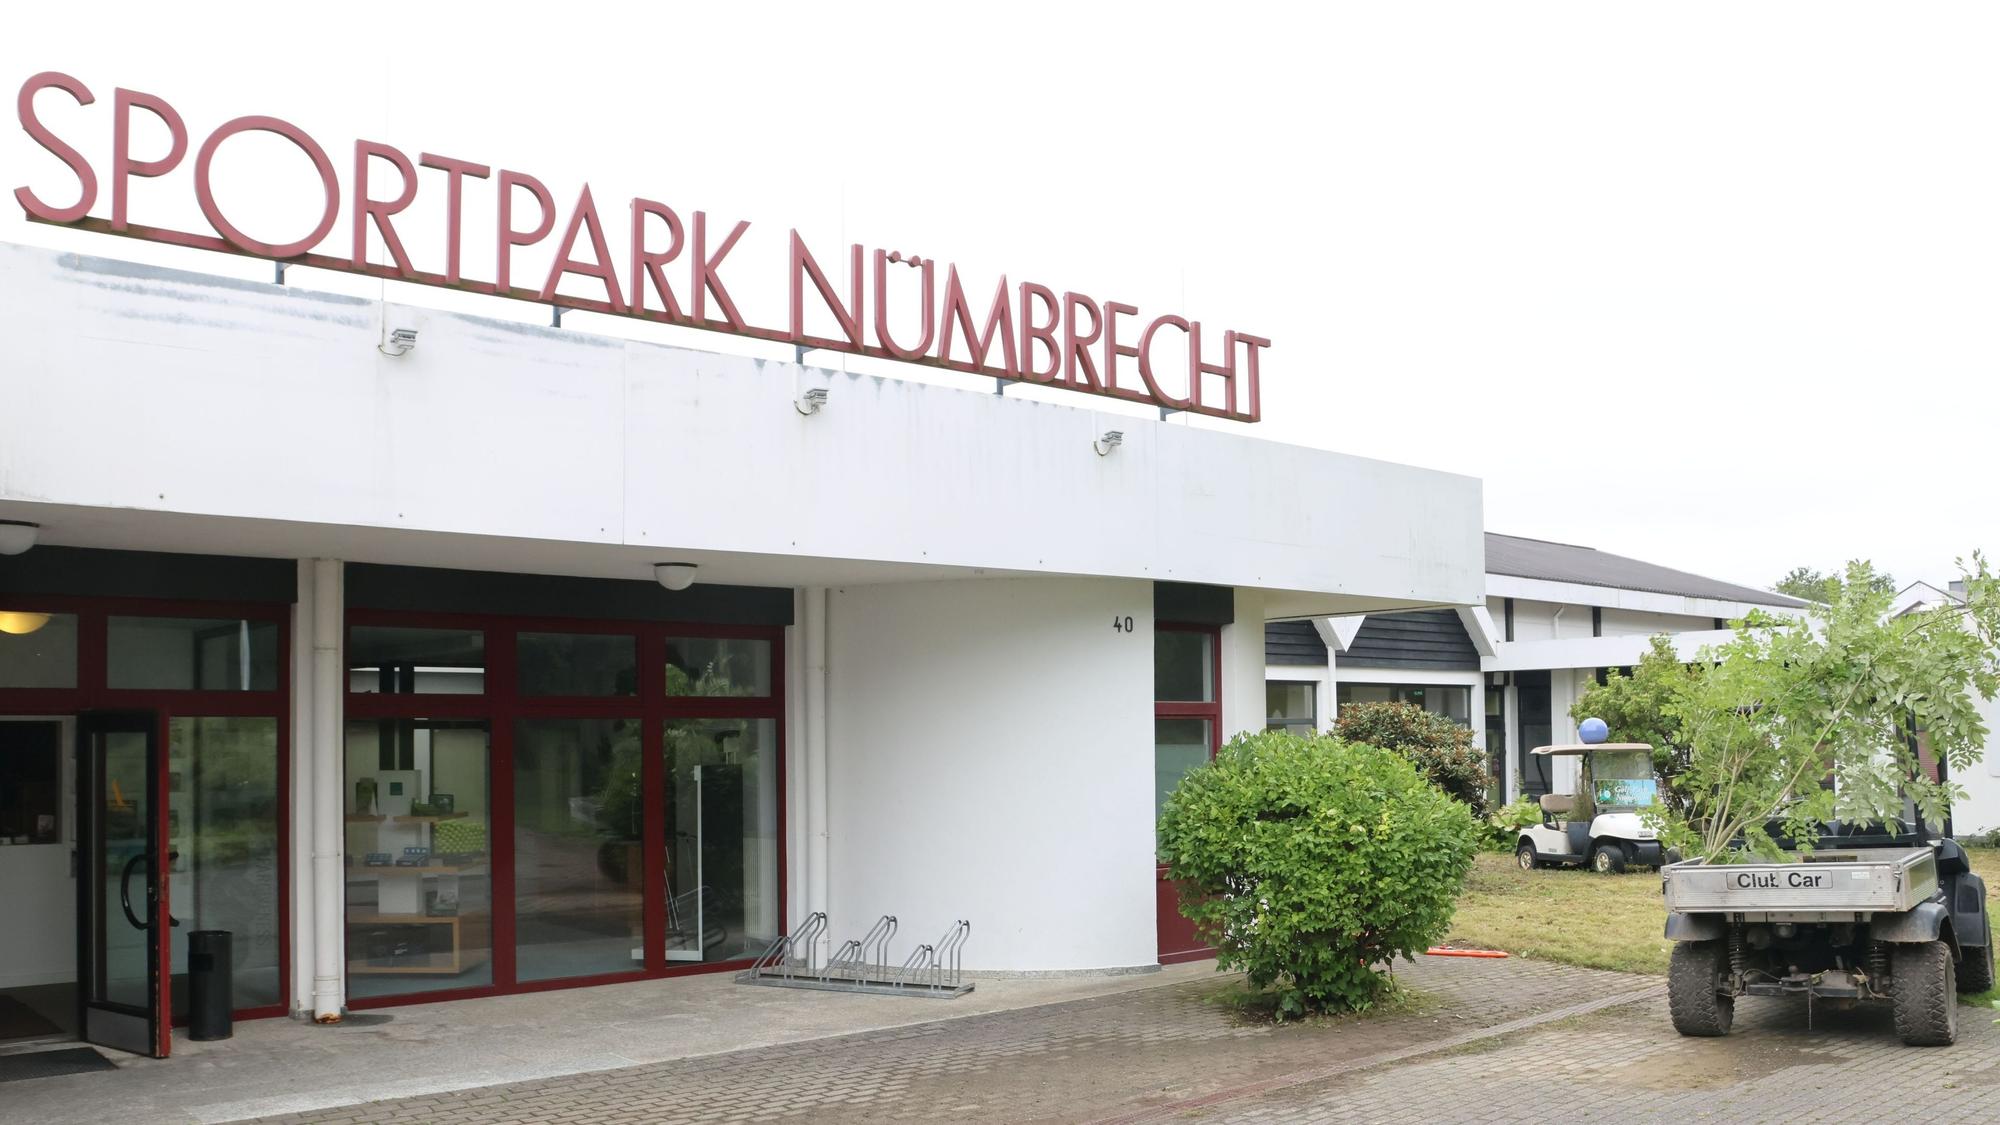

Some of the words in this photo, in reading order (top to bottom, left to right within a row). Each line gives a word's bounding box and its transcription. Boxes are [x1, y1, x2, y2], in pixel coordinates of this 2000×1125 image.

[13, 71, 752, 331] SPORTPARK
[789, 228, 1271, 420] NÜMBRECHT
[1113, 616, 1133, 632] 40
[1788, 872, 1822, 887] Car
